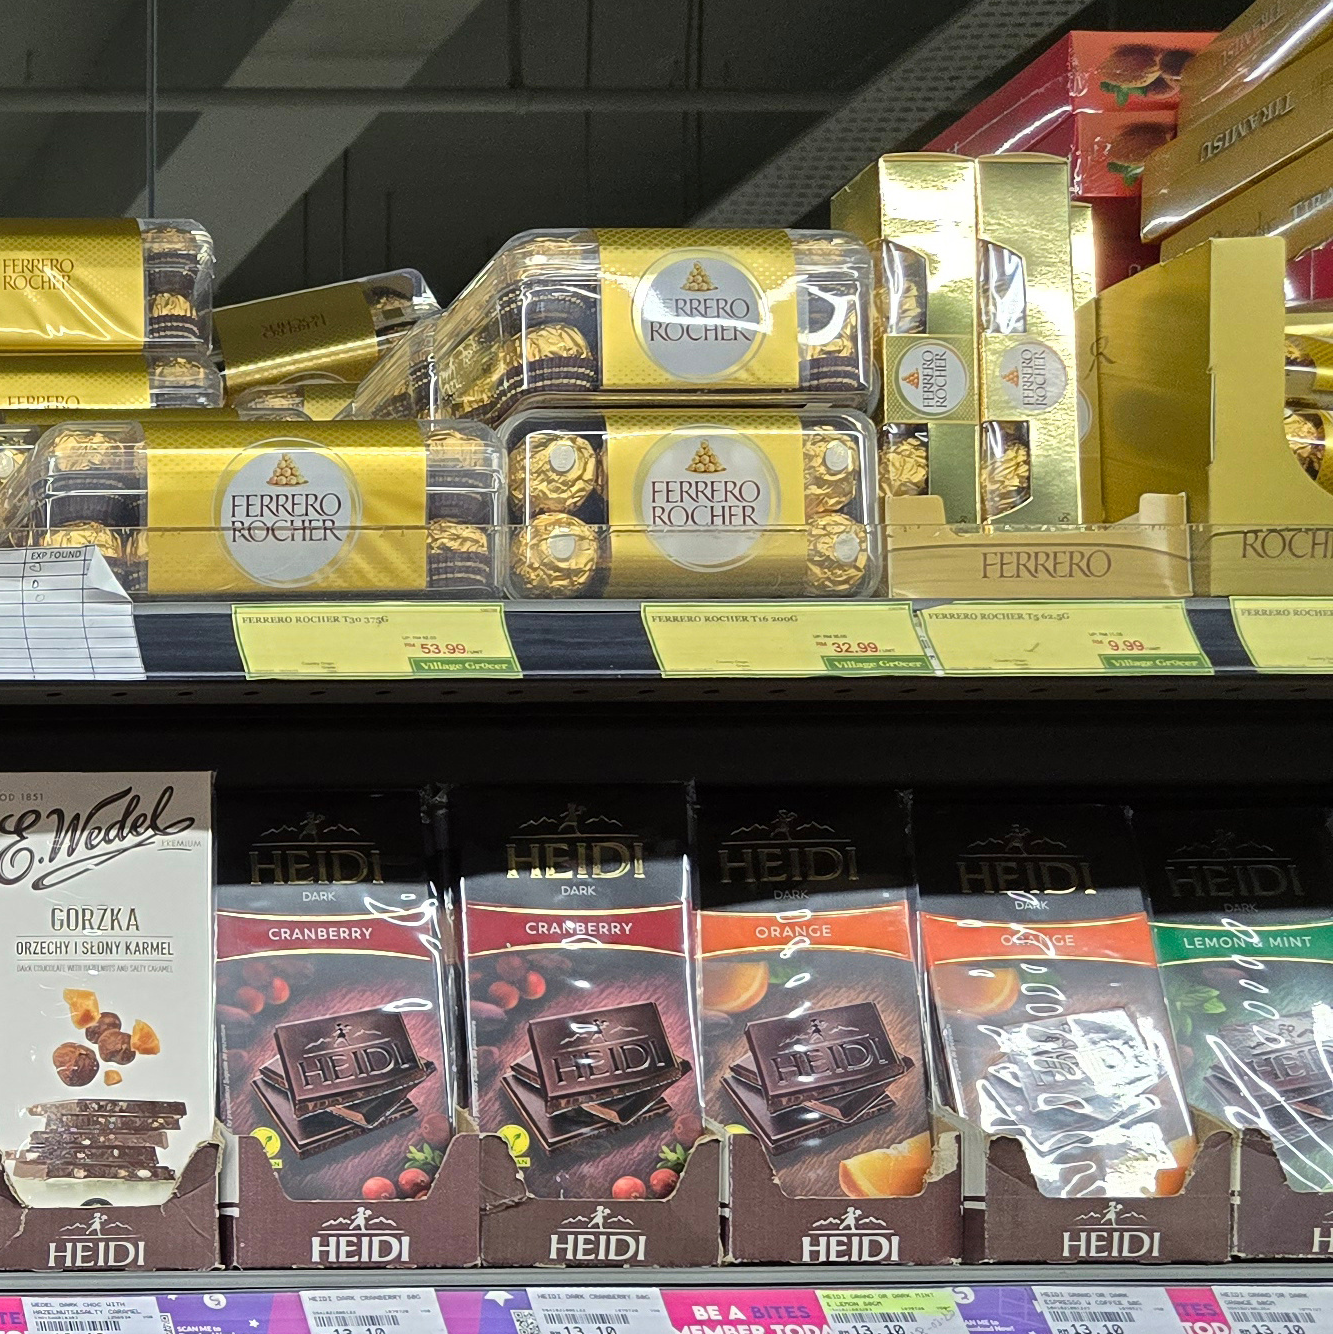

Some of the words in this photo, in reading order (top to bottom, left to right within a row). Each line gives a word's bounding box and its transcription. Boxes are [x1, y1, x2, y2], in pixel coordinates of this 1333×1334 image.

[1199, 92, 1294, 161] TIRAMISU
[2, 257, 74, 275] FERRERO
[2, 273, 71, 292] ROCHER
[649, 320, 752, 343] ROCHER
[922, 350, 934, 409] FERRERO
[935, 351, 947, 408] ROCHER
[652, 480, 760, 505] FERRERO
[230, 492, 342, 519] FERRERO
[652, 504, 758, 528] ROCHER
[230, 517, 342, 543] ROCHER
[982, 550, 1111, 580] FERRERO
[242, 616, 296, 624] FERRERO
[298, 616, 339, 624] ROCHER
[420, 643, 466, 655] 53.99
[832, 642, 878, 654] 32.99
[505, 842, 646, 880] HEIDI
[50, 907, 140, 933] GORZKA
[755, 924, 833, 939] ORANGE
[268, 926, 373, 942] CRANBERRY
[1183, 936, 1247, 949] LEMON
[1269, 936, 1313, 949] MINT
[16, 940, 69, 957] ORZECHY
[125, 939, 174, 957] KARMEL
[802, 1234, 901, 1262] HEIDI
